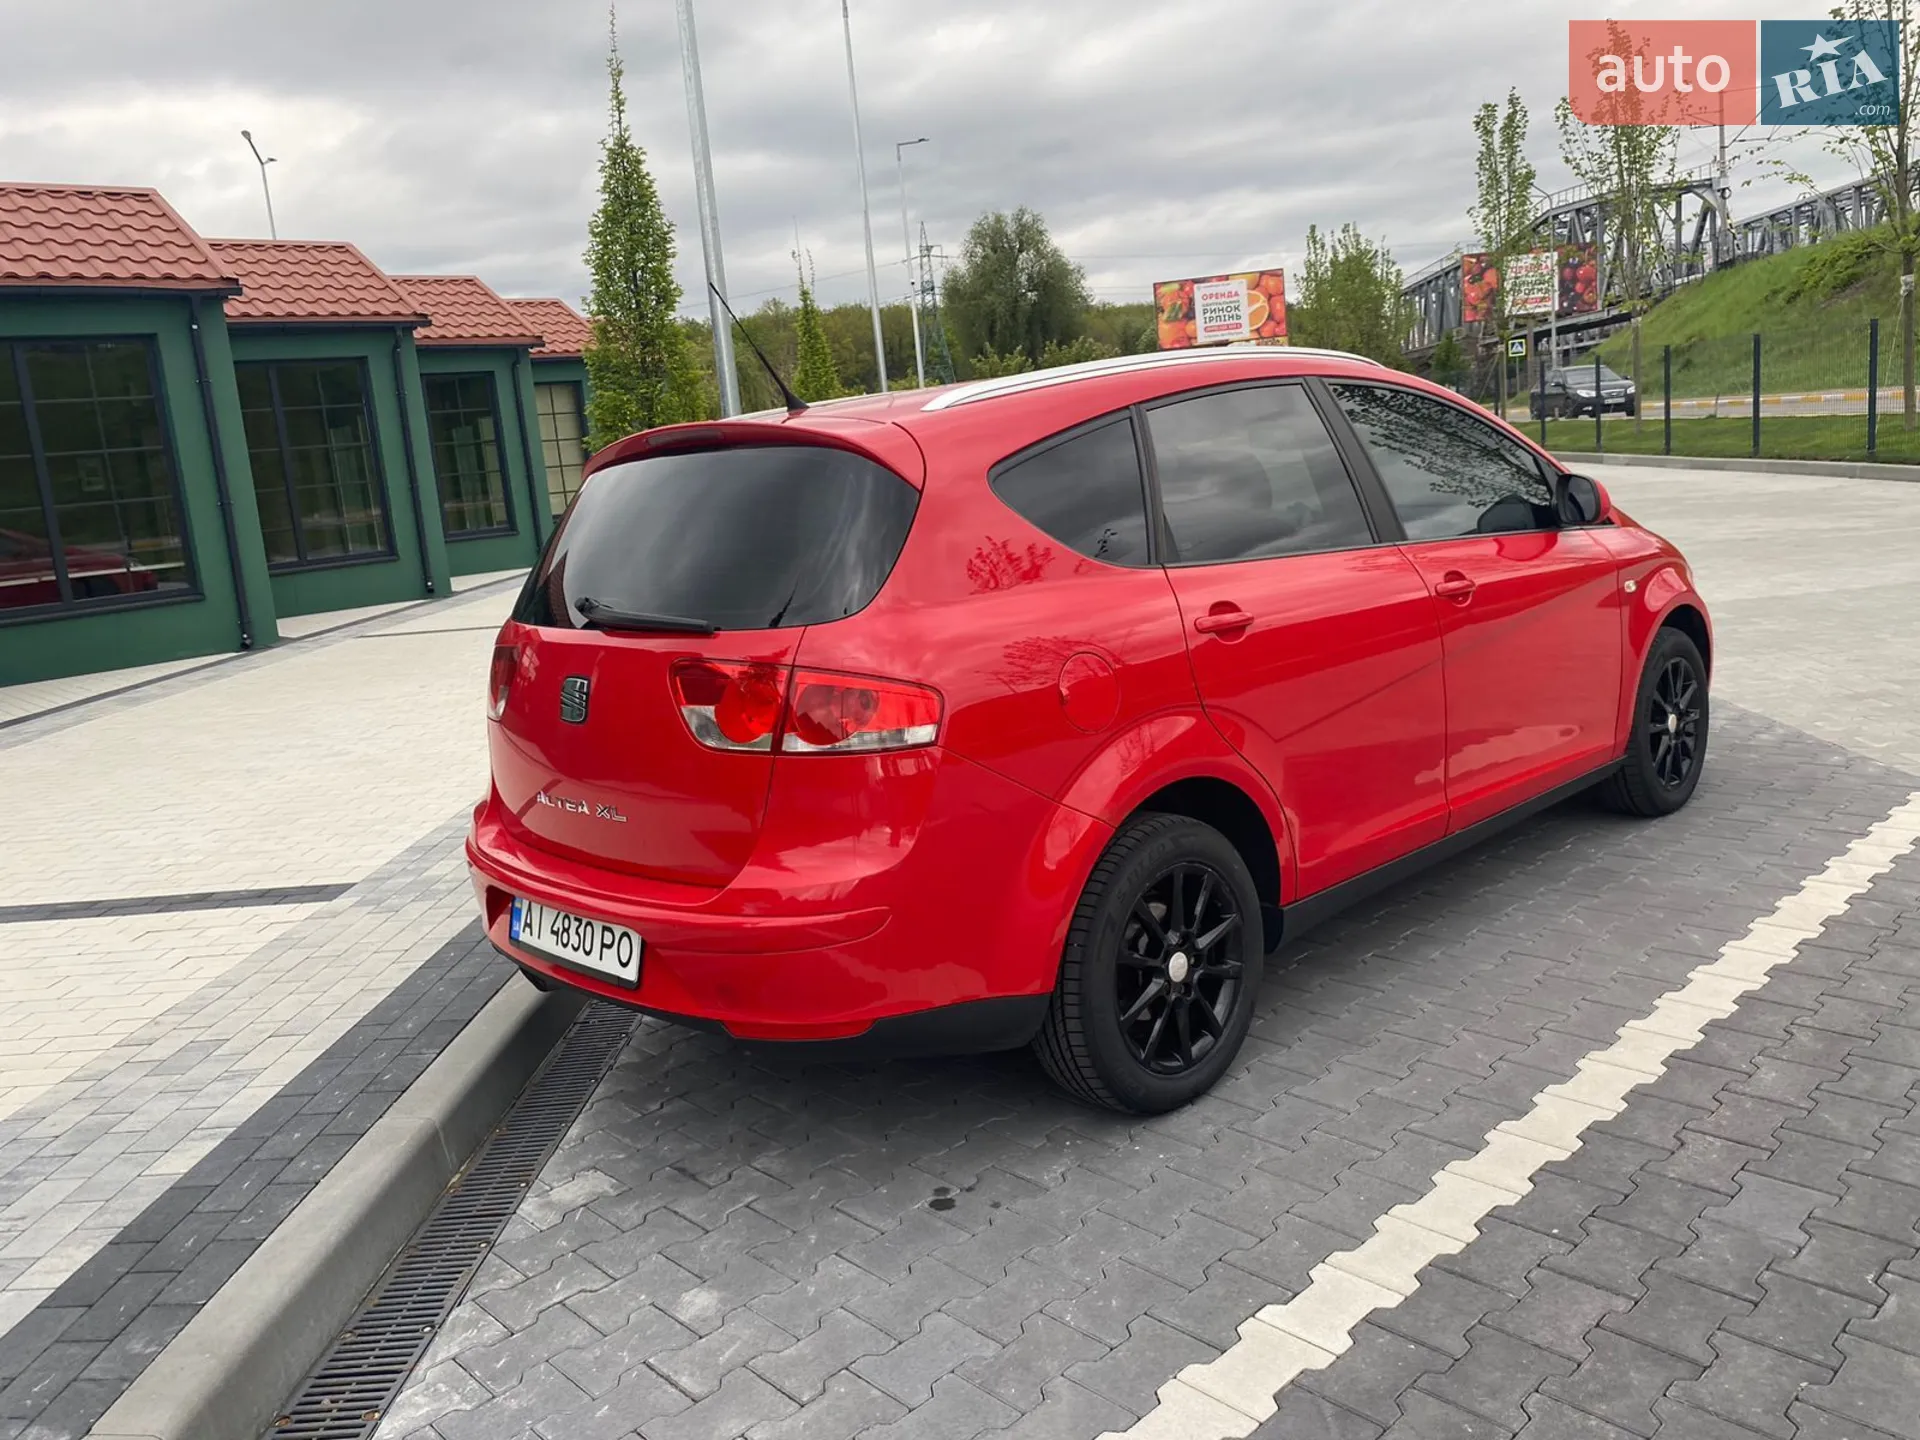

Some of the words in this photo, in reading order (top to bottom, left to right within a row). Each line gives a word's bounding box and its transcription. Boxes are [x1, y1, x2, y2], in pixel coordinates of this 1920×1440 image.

[1202, 290, 1240, 301] ОРЕНДА
[1202, 304, 1241, 316] РИНОК
[1203, 313, 1242, 324] ІРПІНЬ
[536, 790, 590, 816] ALTEA
[596, 803, 628, 823] XL
[522, 901, 543, 940] AI
[550, 911, 595, 957] 4830
[599, 924, 633, 969] PO
